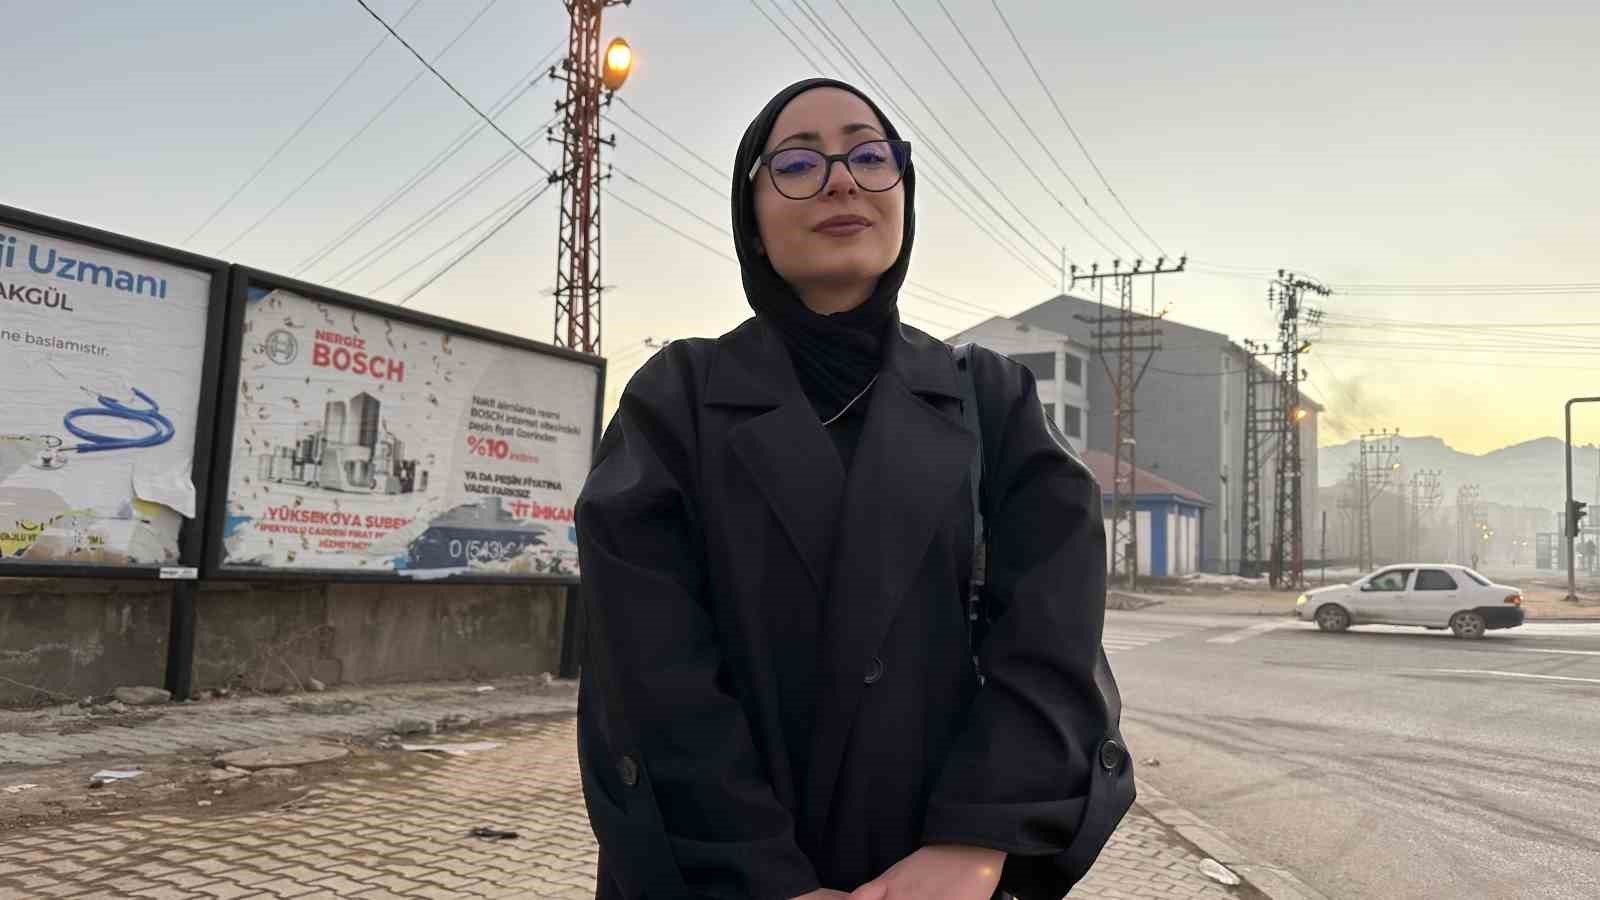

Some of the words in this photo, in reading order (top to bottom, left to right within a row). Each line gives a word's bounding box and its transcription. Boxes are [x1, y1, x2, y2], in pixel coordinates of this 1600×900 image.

[28, 244, 167, 299] Uzmanı
[312, 342, 405, 382] BOSCH
[470, 408, 505, 421] BOSCH
[467, 434, 509, 460] %10
[464, 470, 478, 481] YA
[480, 472, 493, 483] DA
[464, 482, 490, 495] VADE
[268, 506, 362, 528] YÜKSEKOVA
[449, 539, 462, 558] 0
